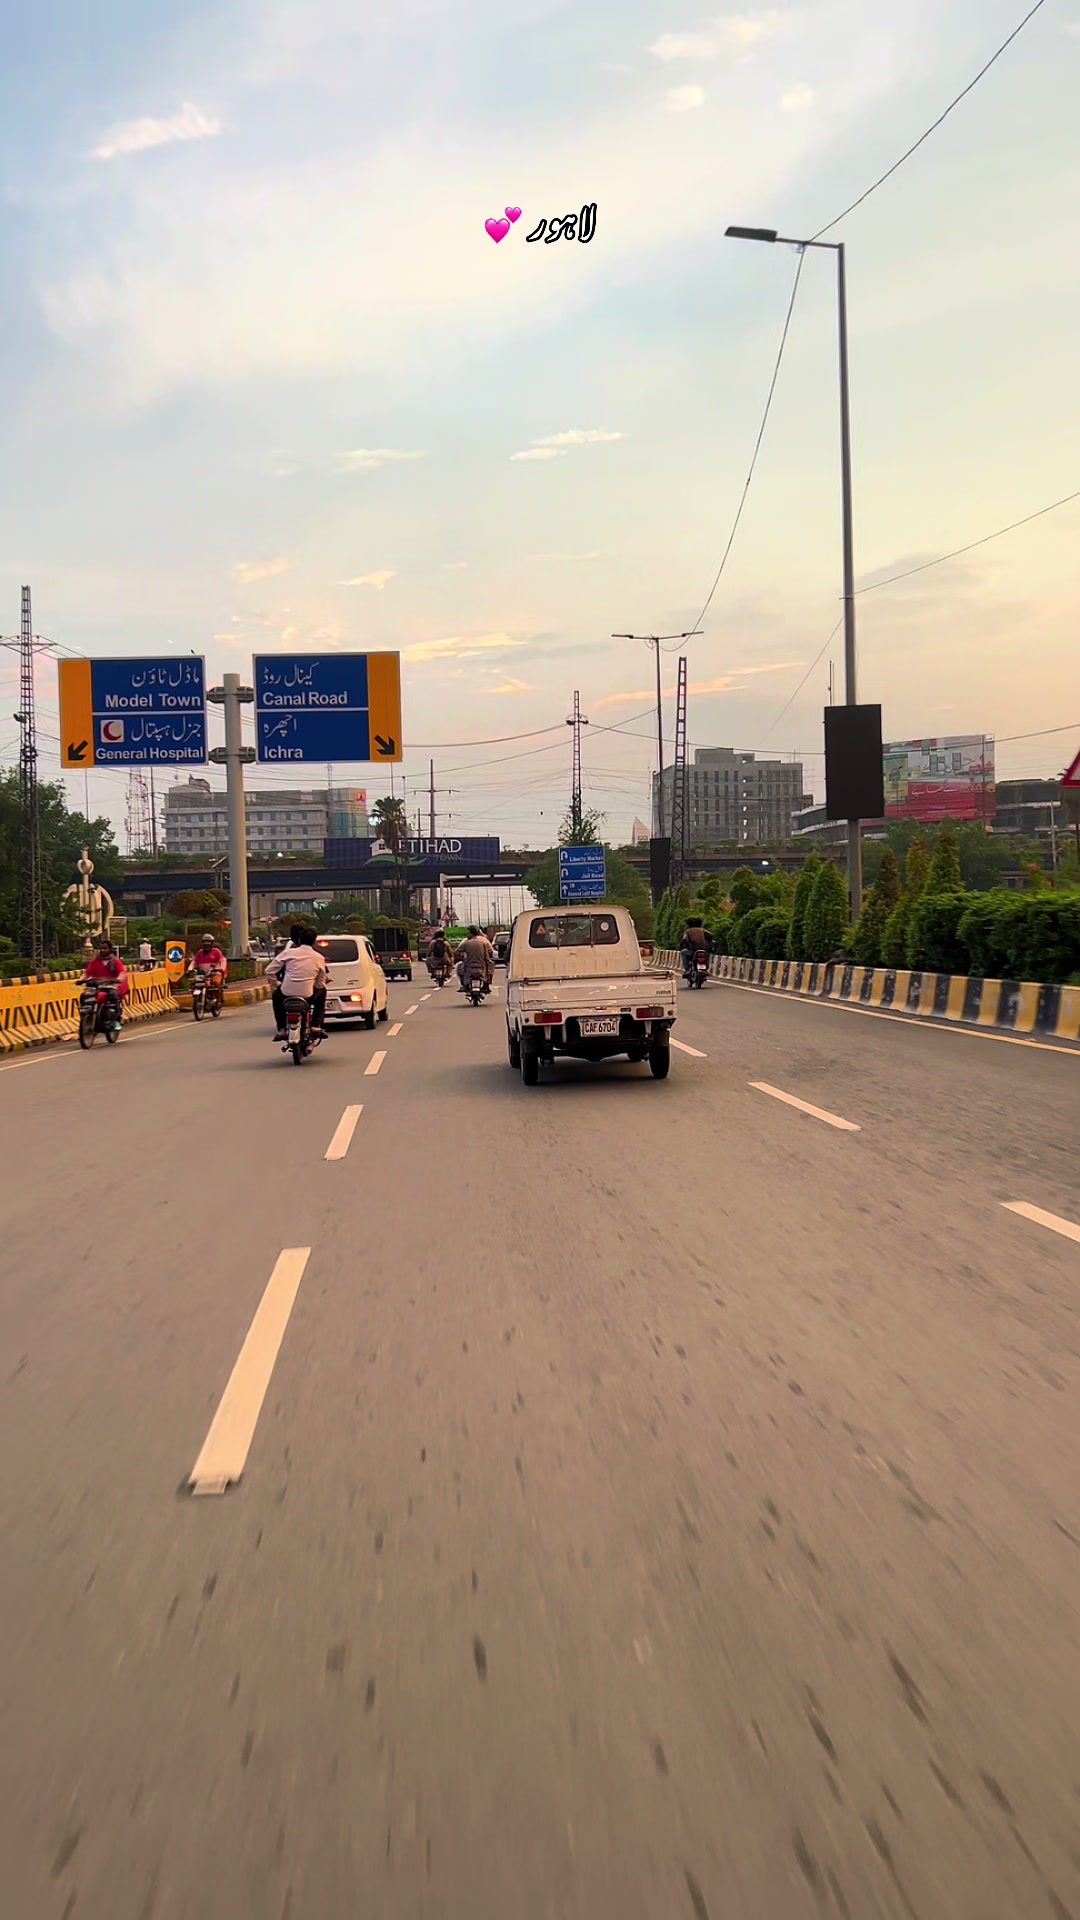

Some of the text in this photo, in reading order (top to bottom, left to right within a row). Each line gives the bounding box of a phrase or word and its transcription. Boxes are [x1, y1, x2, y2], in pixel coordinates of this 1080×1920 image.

[131, 663, 200, 688] ماڈل ٹاؤن
[263, 662, 320, 687] کینال روڈ
[105, 693, 201, 708] Model Town
[262, 691, 348, 706] Canal Road
[131, 718, 171, 742] ہسپتال
[263, 714, 297, 738] اچھرہ
[95, 747, 203, 761] General Hospital
[264, 746, 303, 759] Ichra
[399, 839, 462, 854] ETIHAD
[435, 854, 462, 862] TOWN
[585, 1022, 616, 1033] CAF 6704
